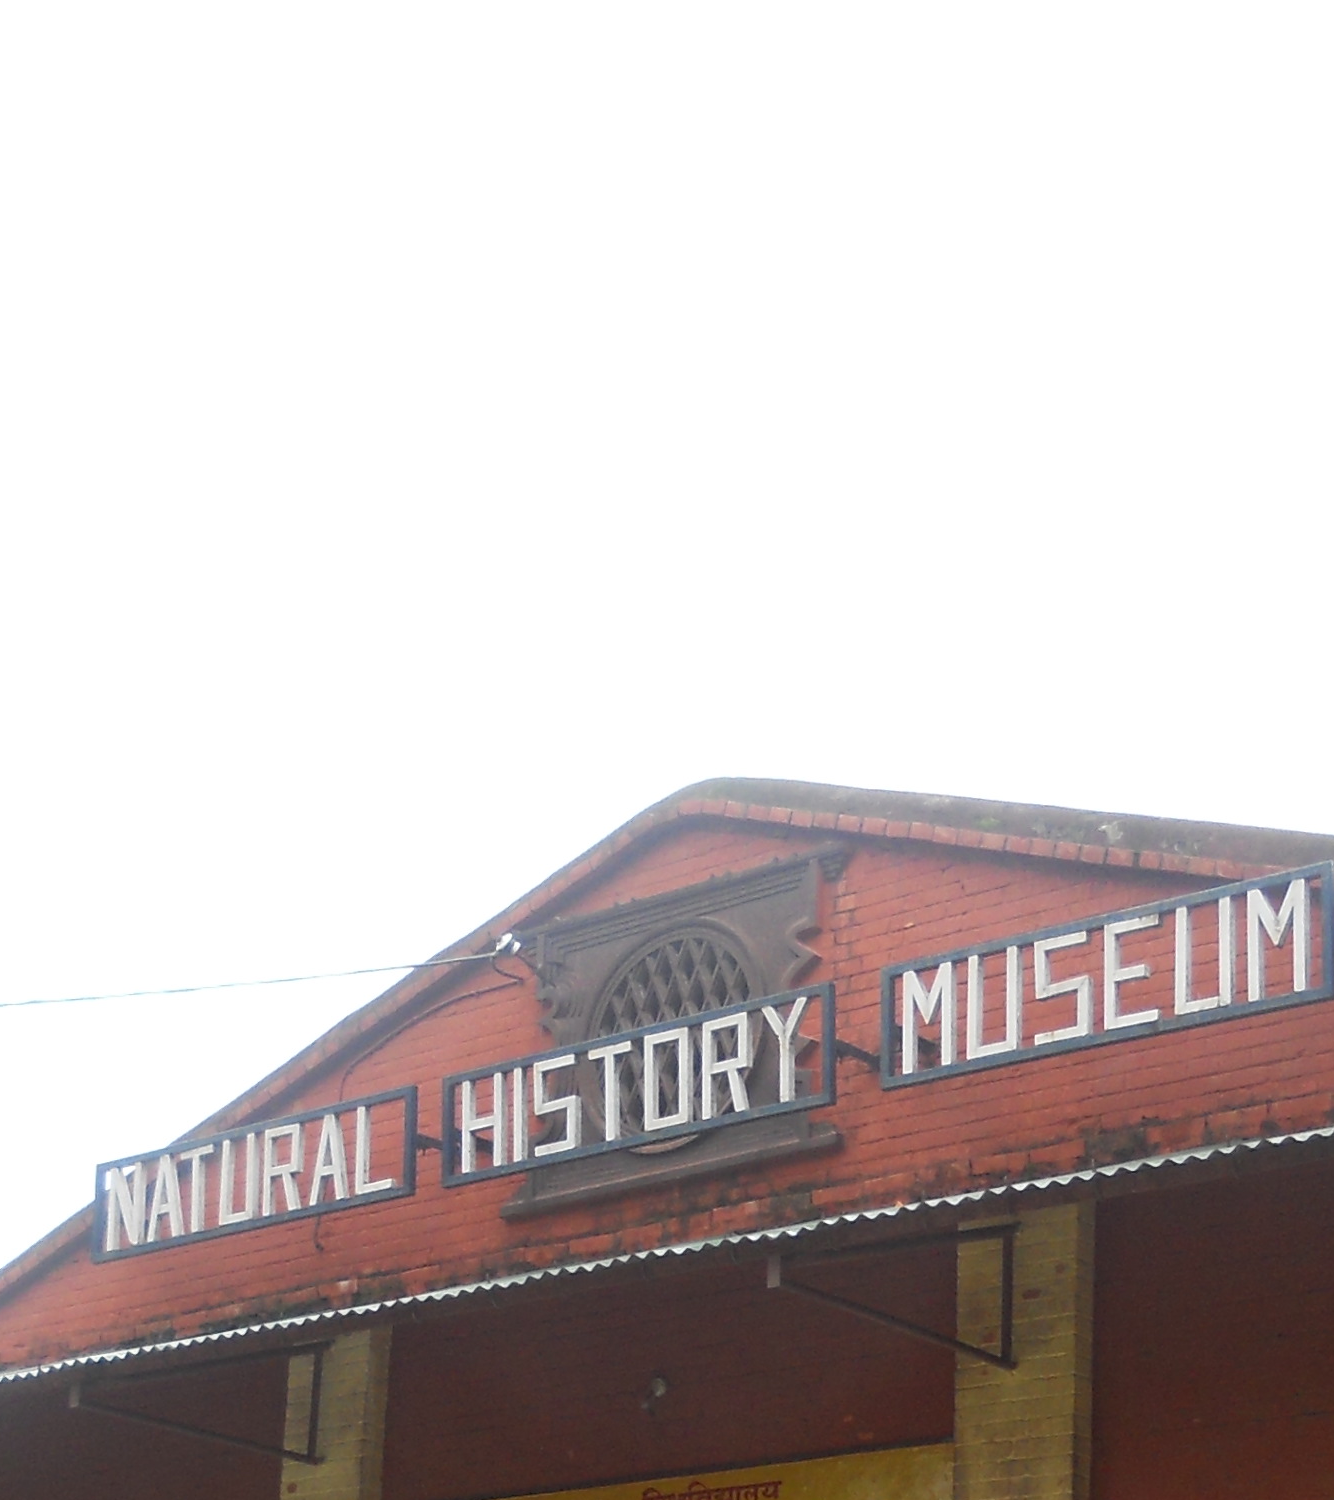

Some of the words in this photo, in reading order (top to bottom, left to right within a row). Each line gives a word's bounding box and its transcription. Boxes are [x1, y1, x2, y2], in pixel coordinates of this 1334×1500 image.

[103, 1104, 396, 1252] NATURAL
[459, 995, 808, 1171] HISTORY
[900, 876, 1310, 1076] MUSEUM
